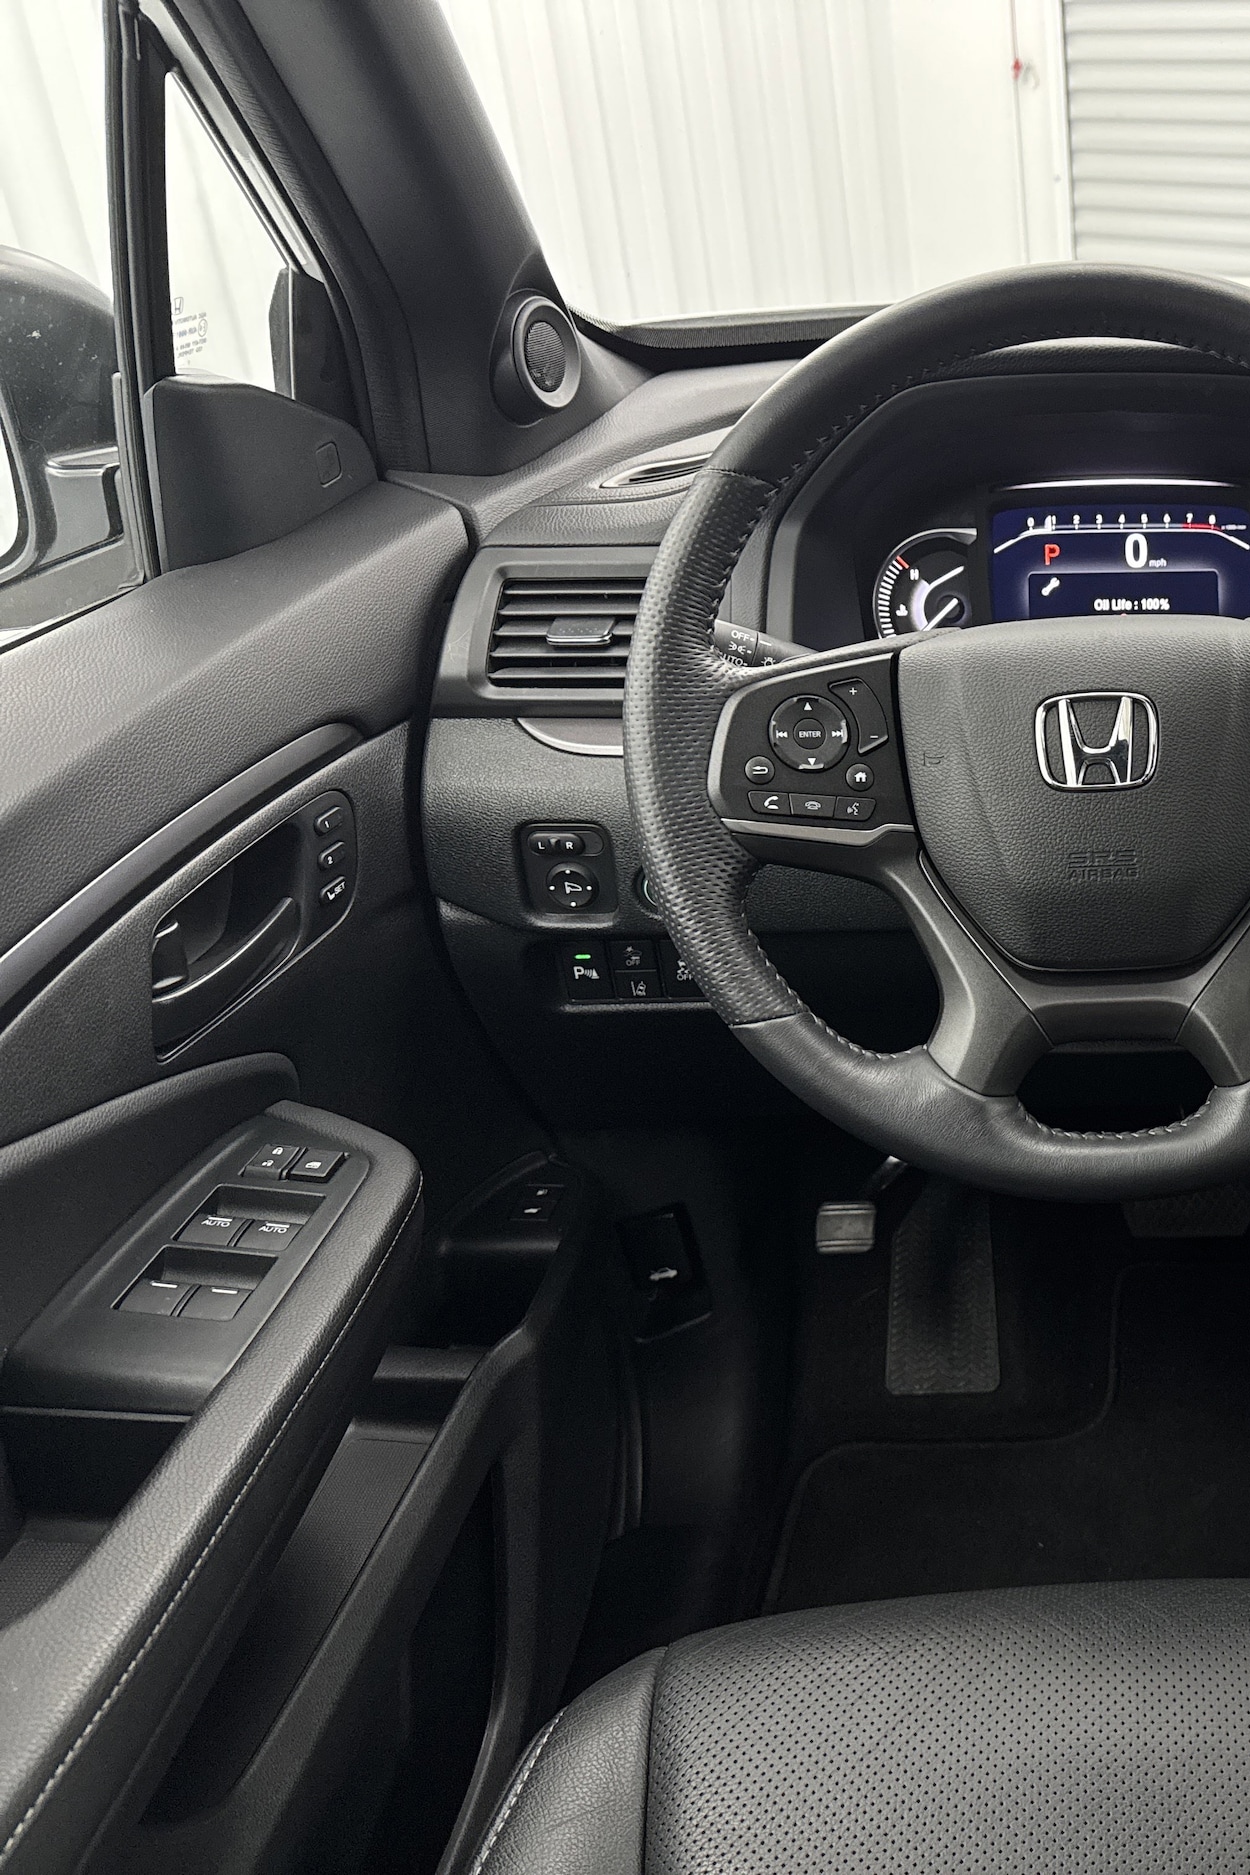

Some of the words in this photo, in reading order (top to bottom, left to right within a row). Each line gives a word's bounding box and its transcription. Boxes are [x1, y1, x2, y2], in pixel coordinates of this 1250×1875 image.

[1027, 517, 1035, 527] 0
[1073, 514, 1081, 524] 2
[1095, 513, 1103, 524] 3
[1118, 513, 1126, 524] 4
[1185, 512, 1194, 522] 7
[1044, 544, 1061, 566] P
[1124, 533, 1148, 569] 0
[1149, 557, 1167, 568] mph
[910, 568, 920, 580] H
[1094, 598, 1110, 611] Oil
[1111, 598, 1132, 611] Life
[1140, 598, 1170, 611] 100%
[731, 630, 750, 641] OFF
[799, 730, 821, 739] ENTER
[538, 841, 545, 850] L
[565, 841, 573, 850] R
[327, 855, 334, 865] 2
[1067, 850, 1137, 866] SRS
[1069, 867, 1138, 880] AIRBAG
[334, 881, 346, 895] SET
[625, 959, 641, 967] OFF
[201, 1219, 231, 1228] AUTO
[258, 1225, 288, 1234] AUTO
